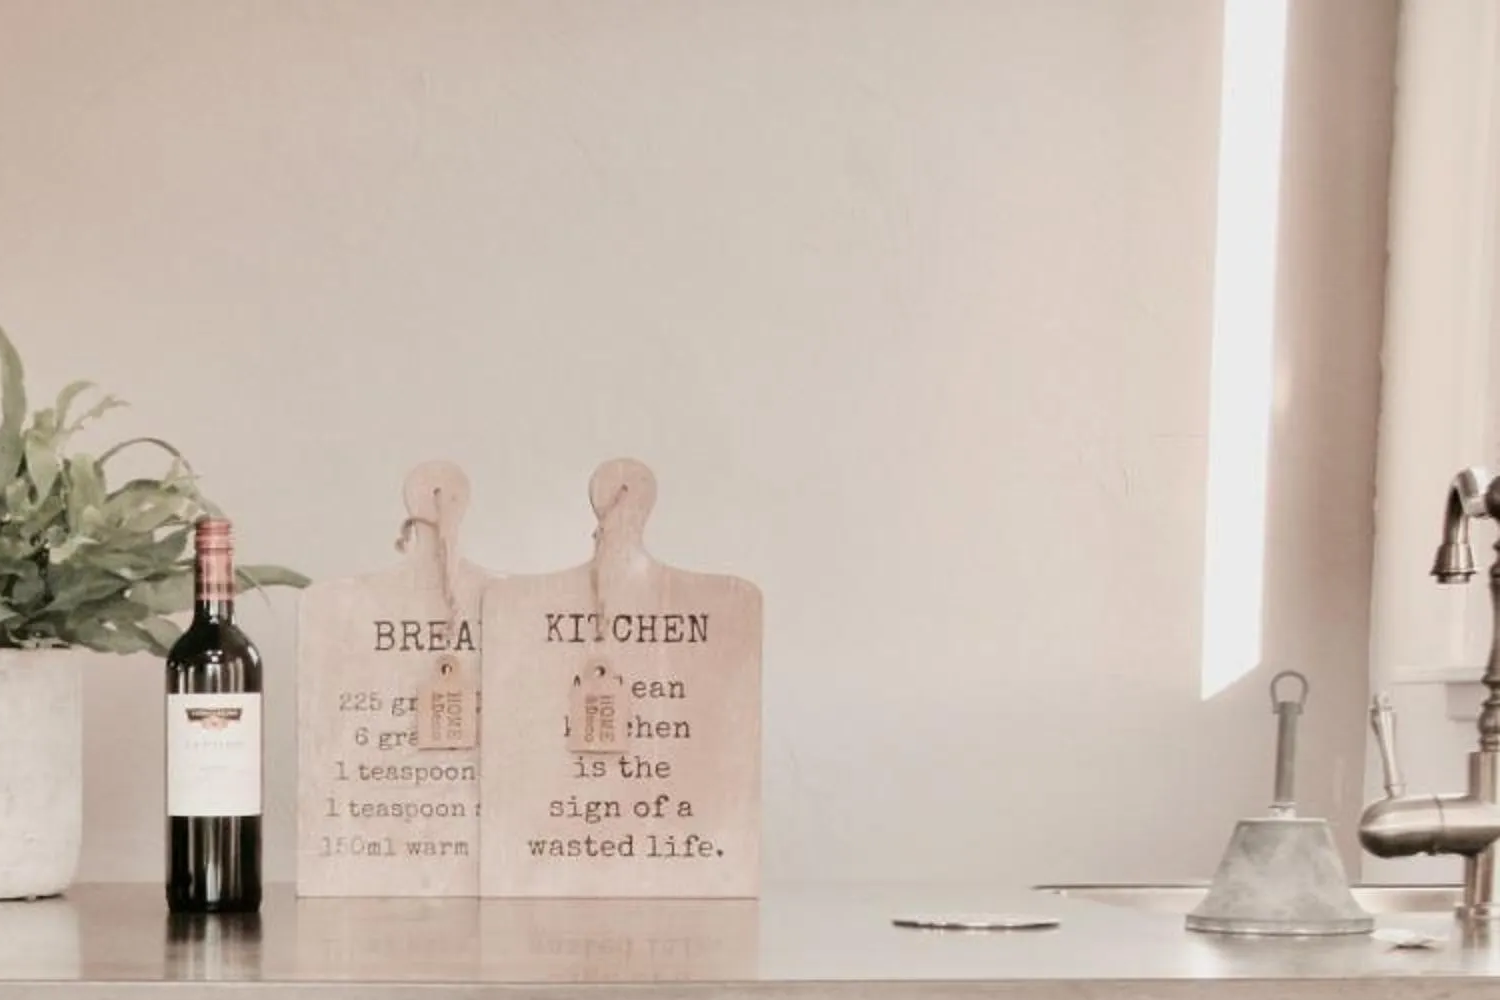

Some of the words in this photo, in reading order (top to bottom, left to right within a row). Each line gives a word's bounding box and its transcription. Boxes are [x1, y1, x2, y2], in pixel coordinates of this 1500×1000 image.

[373, 620, 482, 651] BREA
[545, 613, 709, 643] KITCHEN
[339, 691, 382, 712] 225
[355, 727, 369, 746] 6
[379, 732, 418, 751] gra
[358, 764, 477, 785] teaspoon
[573, 755, 607, 778] is
[618, 755, 671, 779] the
[349, 802, 466, 824] teaspoon
[549, 795, 621, 825] sign
[633, 794, 669, 818] of
[677, 800, 694, 817] a
[404, 840, 470, 857] warm
[527, 834, 635, 858] wasted
[646, 834, 725, 858] life.
